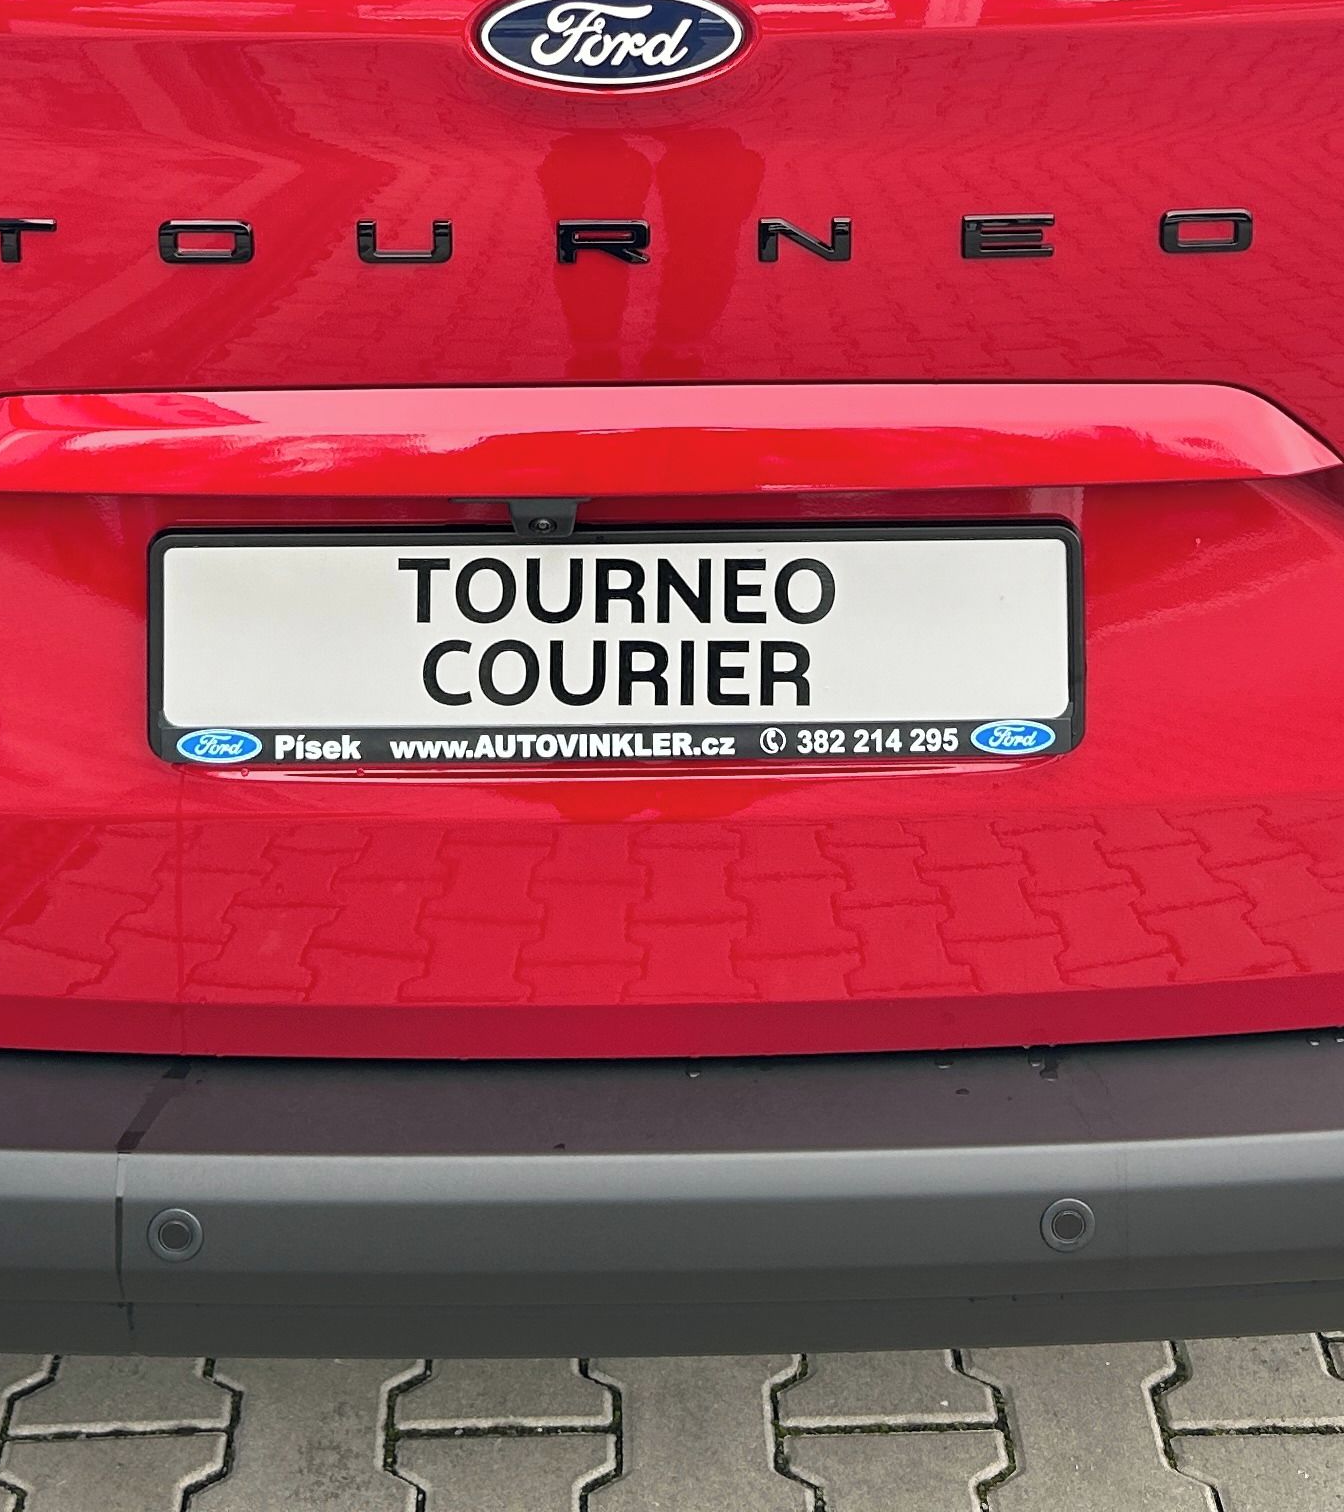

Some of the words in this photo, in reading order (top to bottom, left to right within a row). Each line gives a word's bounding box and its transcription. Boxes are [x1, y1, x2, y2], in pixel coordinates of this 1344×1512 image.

[530, 1, 691, 69] Ford
[398, 557, 836, 624] TOURNEO
[422, 640, 811, 707] COURIER
[193, 735, 243, 757] Ford
[275, 732, 362, 761] Písek
[391, 734, 735, 760] www.AUTOVINKLER.cz
[796, 731, 847, 753] 382
[853, 730, 902, 753] 214
[909, 728, 959, 752] 295
[988, 727, 1039, 749] Ford
